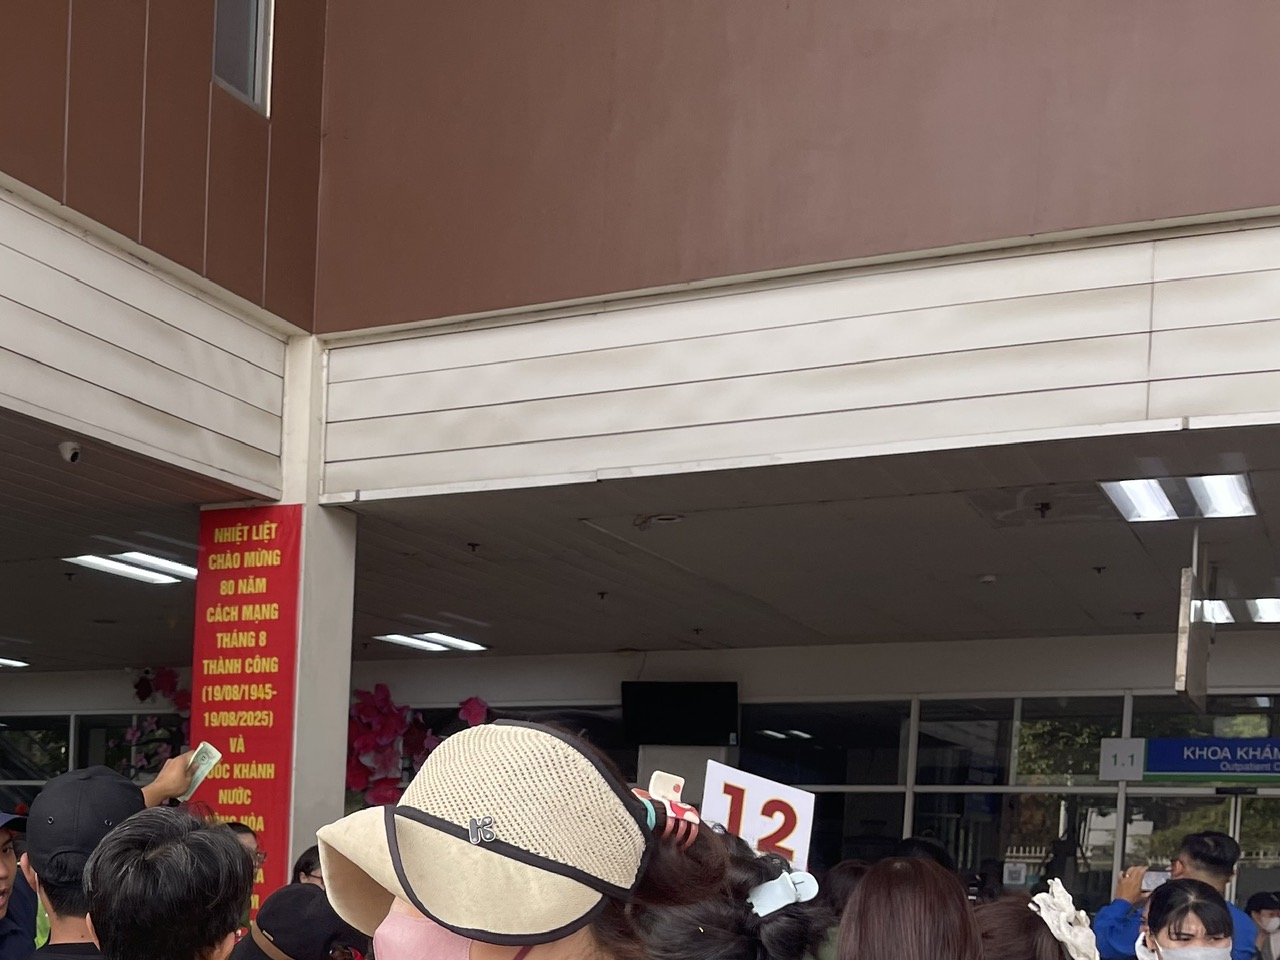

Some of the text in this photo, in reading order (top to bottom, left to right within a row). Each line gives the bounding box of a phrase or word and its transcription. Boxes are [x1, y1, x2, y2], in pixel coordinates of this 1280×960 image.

[214, 522, 277, 546] NHIỆT LIỆT
[208, 546, 281, 570] CHÀO MỪNG
[220, 575, 267, 595] 80 NĂM
[206, 602, 279, 623] CÁCH MẠNG
[216, 629, 267, 648] THÁNG 8
[202, 655, 279, 675] THÀNH CÔNG
[201, 683, 277, 704] (19/08/1945-
[203, 710, 273, 729] 19/08/2025)
[229, 735, 245, 753] VÀ
[1183, 746, 1232, 760] KHOA
[233, 760, 275, 779] KHÁNH
[1111, 753, 1135, 768] 1.1
[218, 786, 252, 805] NƯỚC
[721, 783, 798, 859] 12
